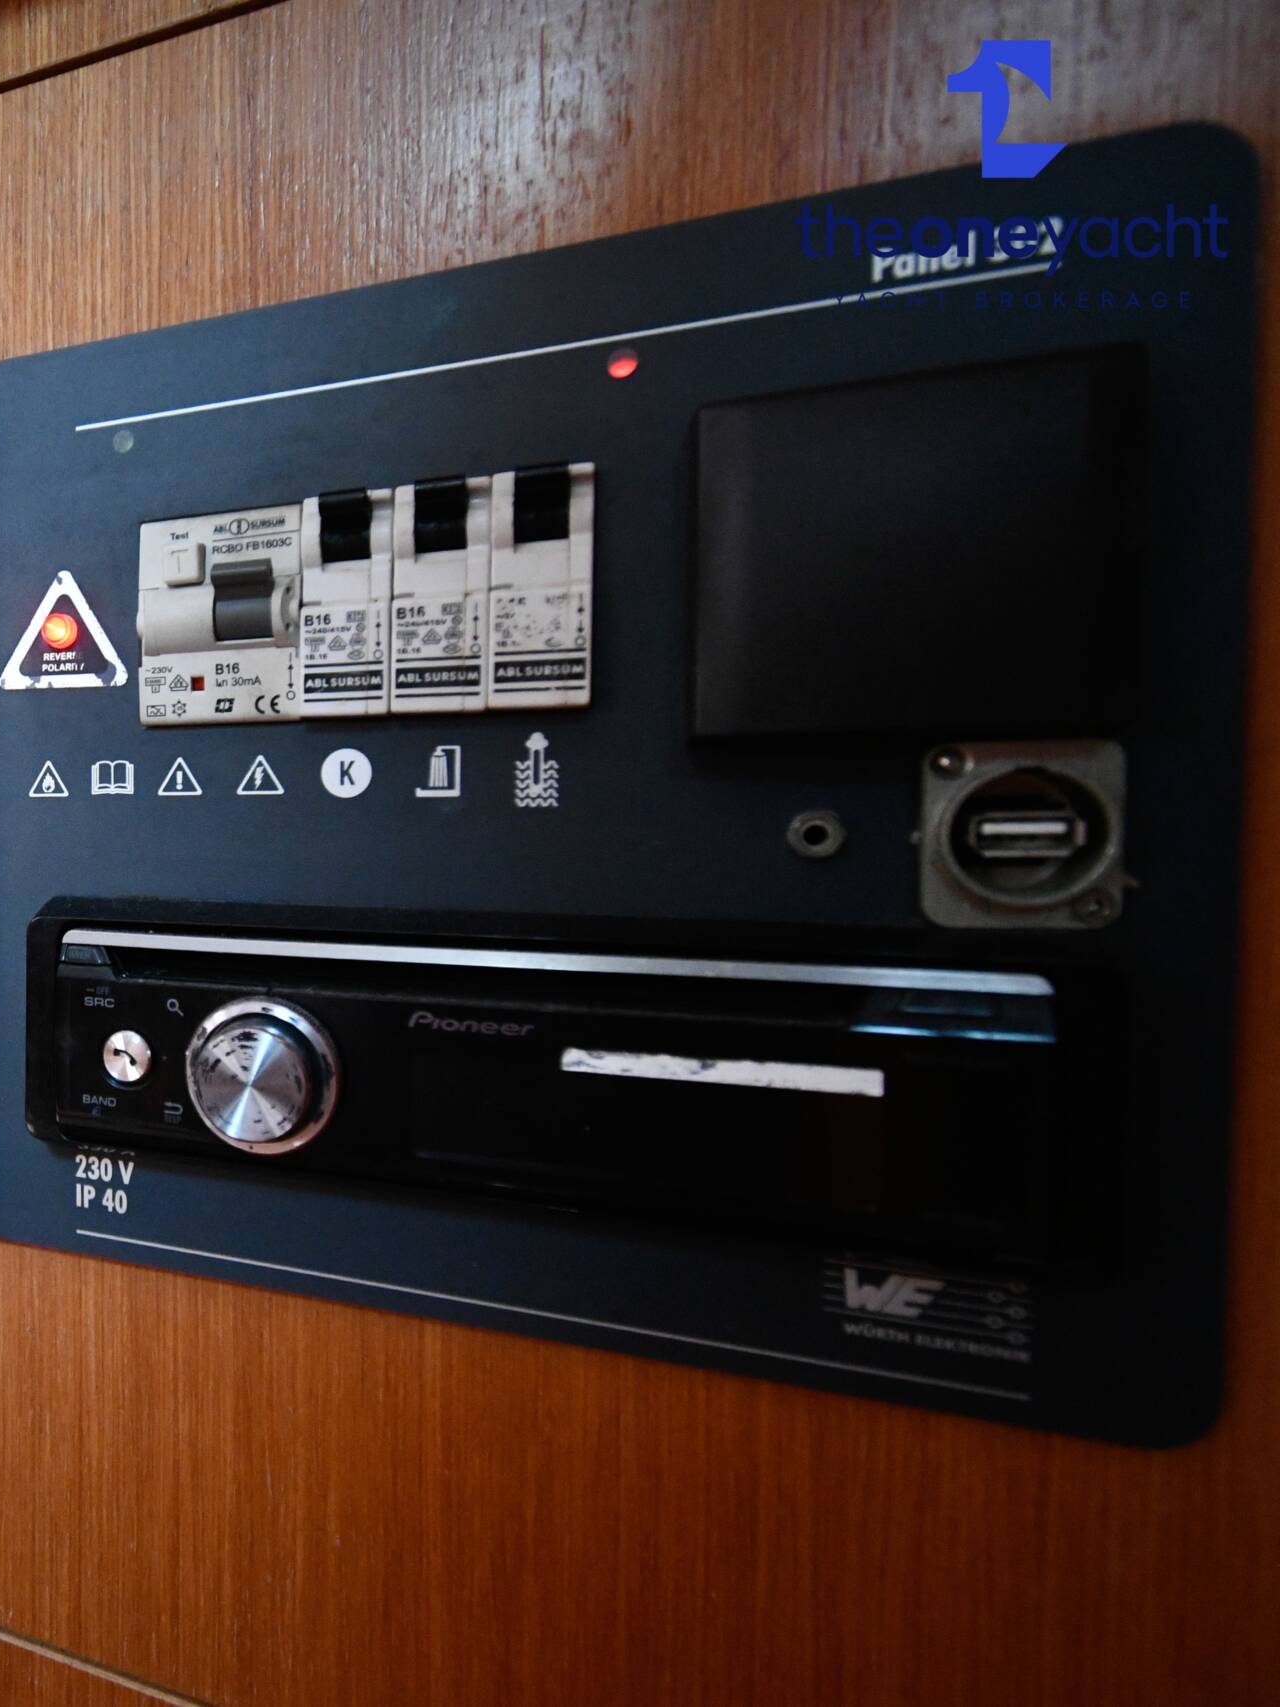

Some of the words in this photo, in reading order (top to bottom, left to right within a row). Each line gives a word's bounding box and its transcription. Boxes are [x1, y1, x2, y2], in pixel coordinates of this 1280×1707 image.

[169, 532, 190, 541] Test
[211, 542, 244, 555] RCBO
[245, 536, 293, 551] FB1603C
[304, 613, 332, 627] B16
[215, 663, 240, 676] B16
[496, 666, 525, 678] ABL
[525, 664, 586, 677] SURSUM
[231, 676, 262, 687] 30mA
[305, 678, 330, 689] ABL
[329, 674, 383, 687] SURSUM
[397, 672, 423, 684] ABL
[423, 670, 480, 683] SURSUM
[339, 760, 356, 786] K
[83, 996, 115, 1009] SRC
[408, 1010, 535, 1036] Pioneer
[82, 1093, 117, 1107] BAND
[74, 1154, 114, 1183] 230
[118, 1160, 135, 1185] V
[75, 1183, 96, 1209] IP
[101, 1188, 128, 1215] 40
